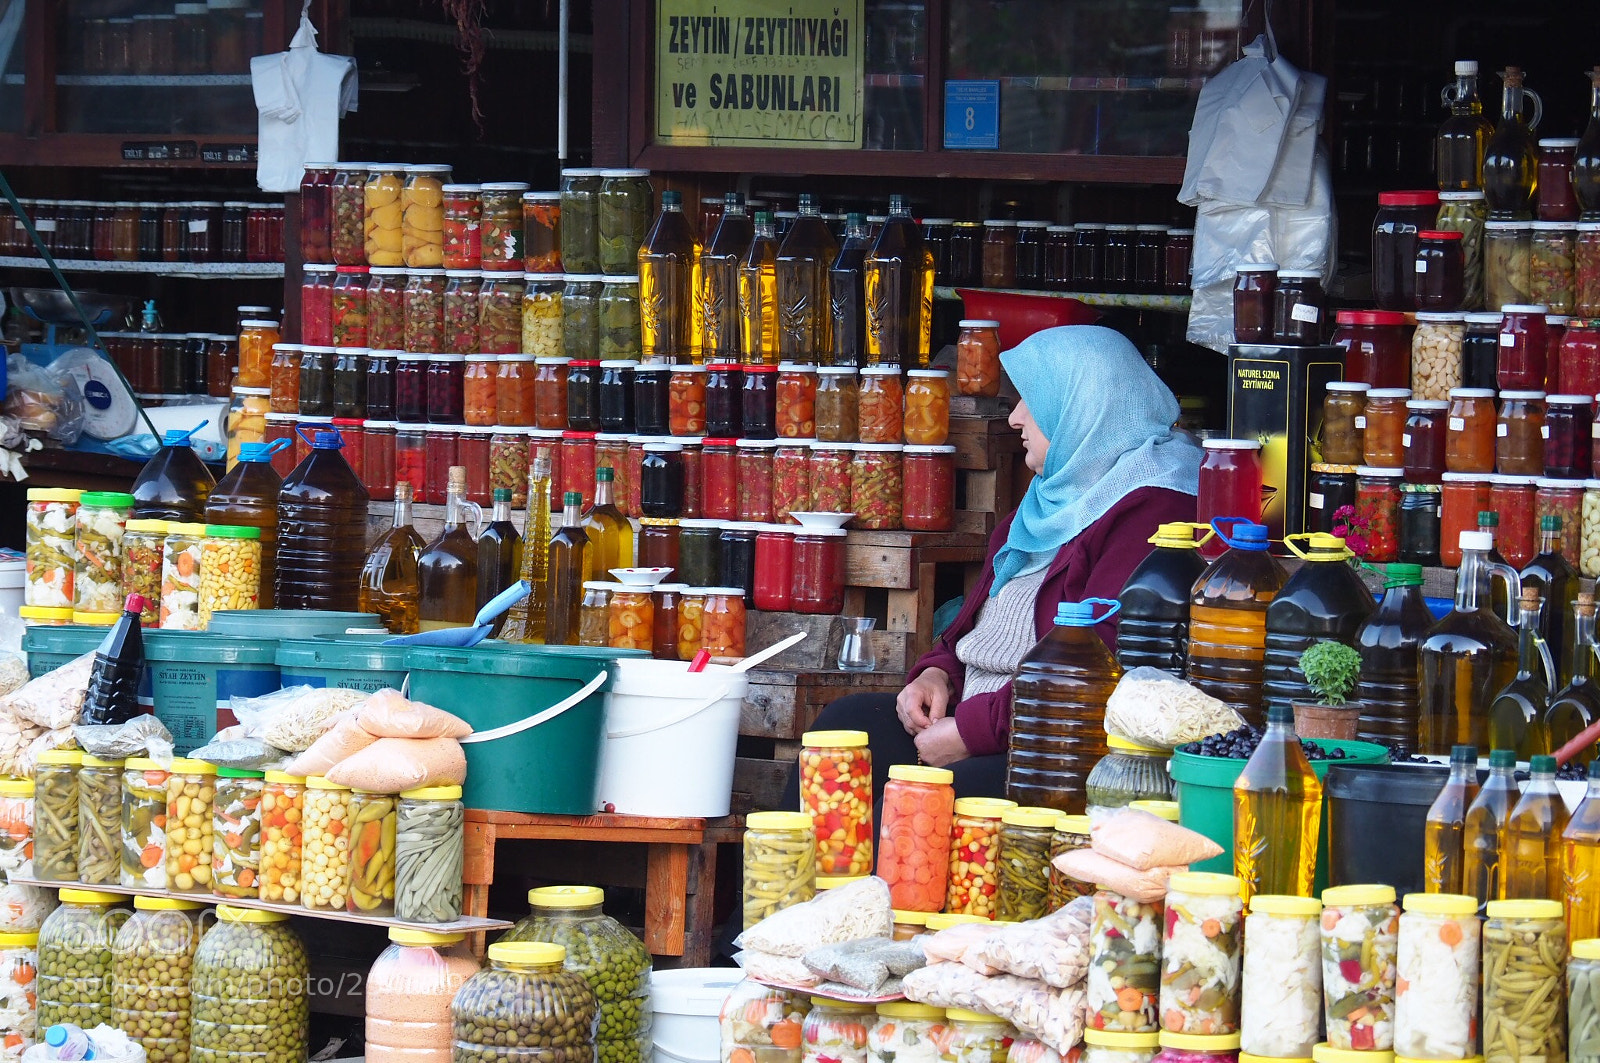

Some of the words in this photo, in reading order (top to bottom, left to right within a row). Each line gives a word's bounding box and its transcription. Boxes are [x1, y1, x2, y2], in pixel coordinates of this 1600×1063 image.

[673, 82, 697, 109] ve
[709, 73, 840, 113] SABUNLARI
[965, 106, 975, 131] 8
[1238, 369, 1261, 379] NATUREL
[1262, 370, 1280, 380] SIZMA
[1242, 379, 1274, 390] ZEYTİNYAĞI
[159, 670, 177, 680] SİYAH
[180, 672, 206, 681] ZEYTİN
